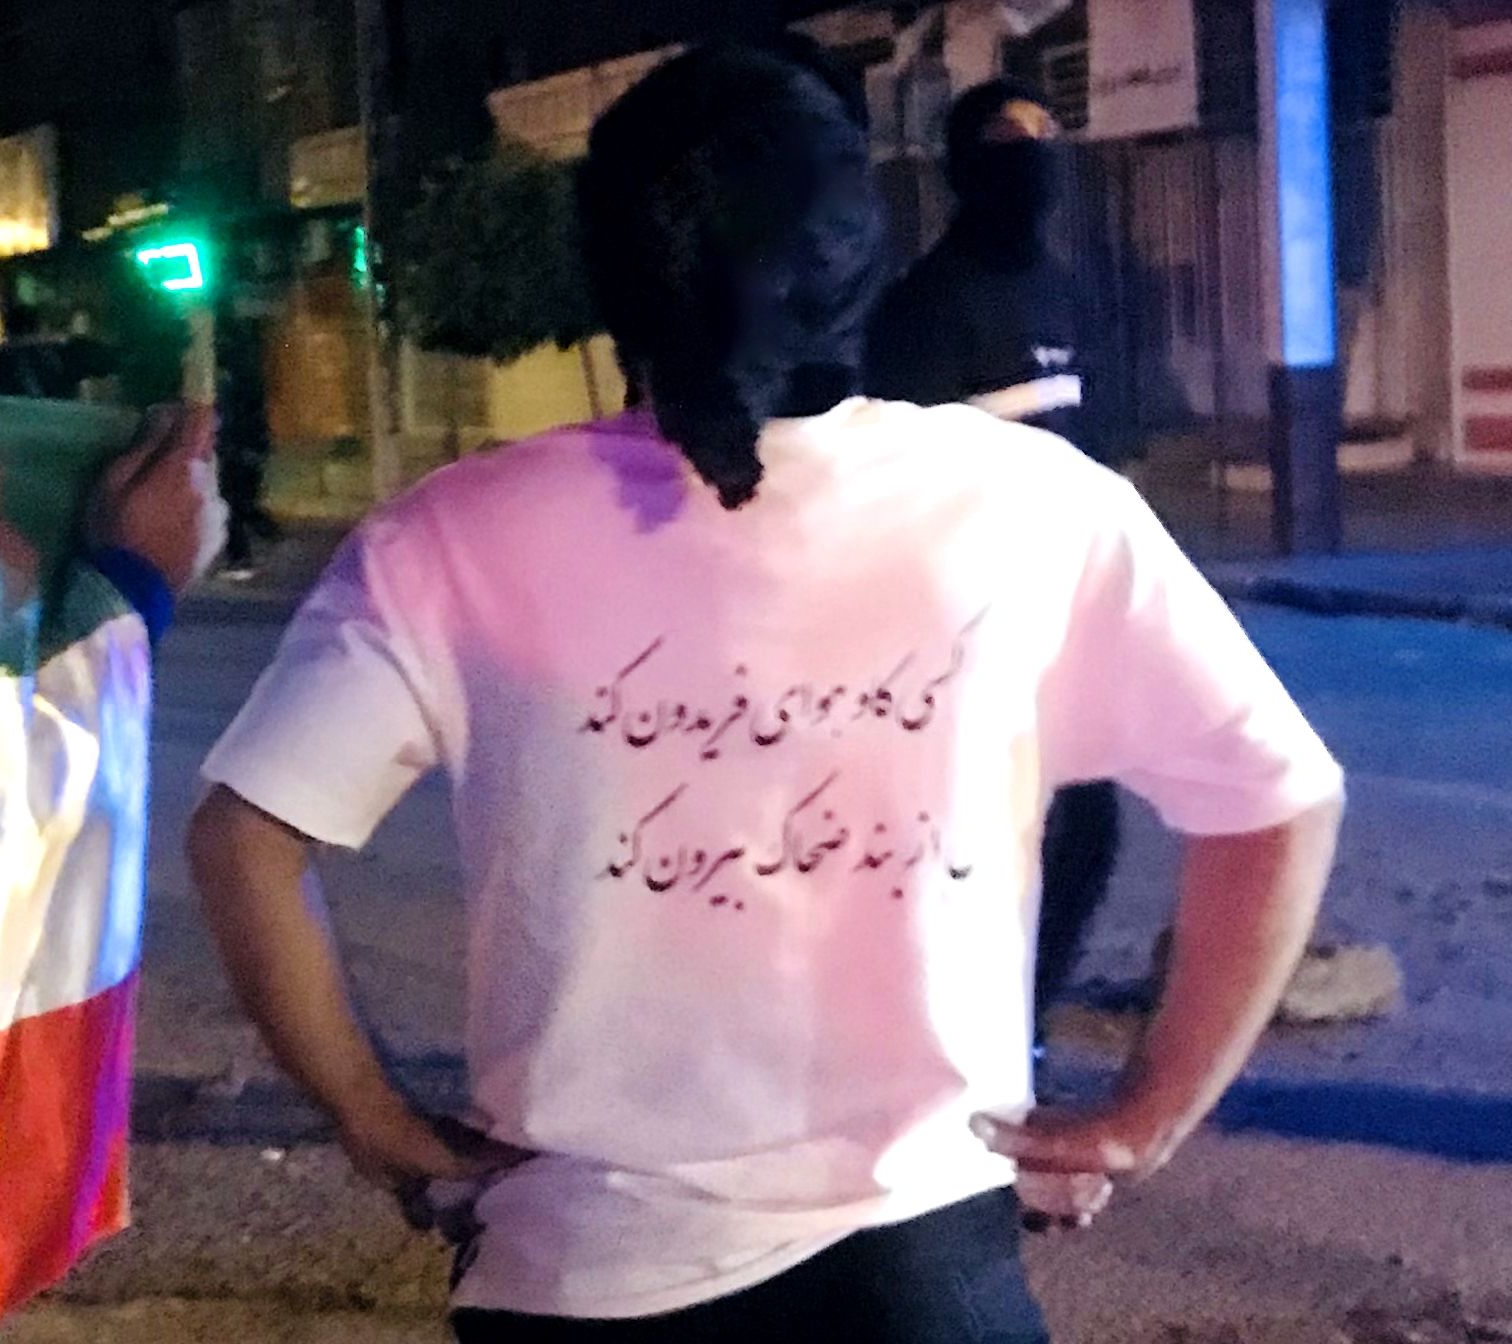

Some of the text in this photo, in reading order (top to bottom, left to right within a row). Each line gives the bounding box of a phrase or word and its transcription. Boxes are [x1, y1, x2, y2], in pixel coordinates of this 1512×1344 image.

[577, 636, 666, 733] کند
[620, 663, 749, 761] فریدون
[594, 781, 691, 880] کند
[755, 770, 851, 877] ضحاک
[642, 844, 747, 912] بیرون
